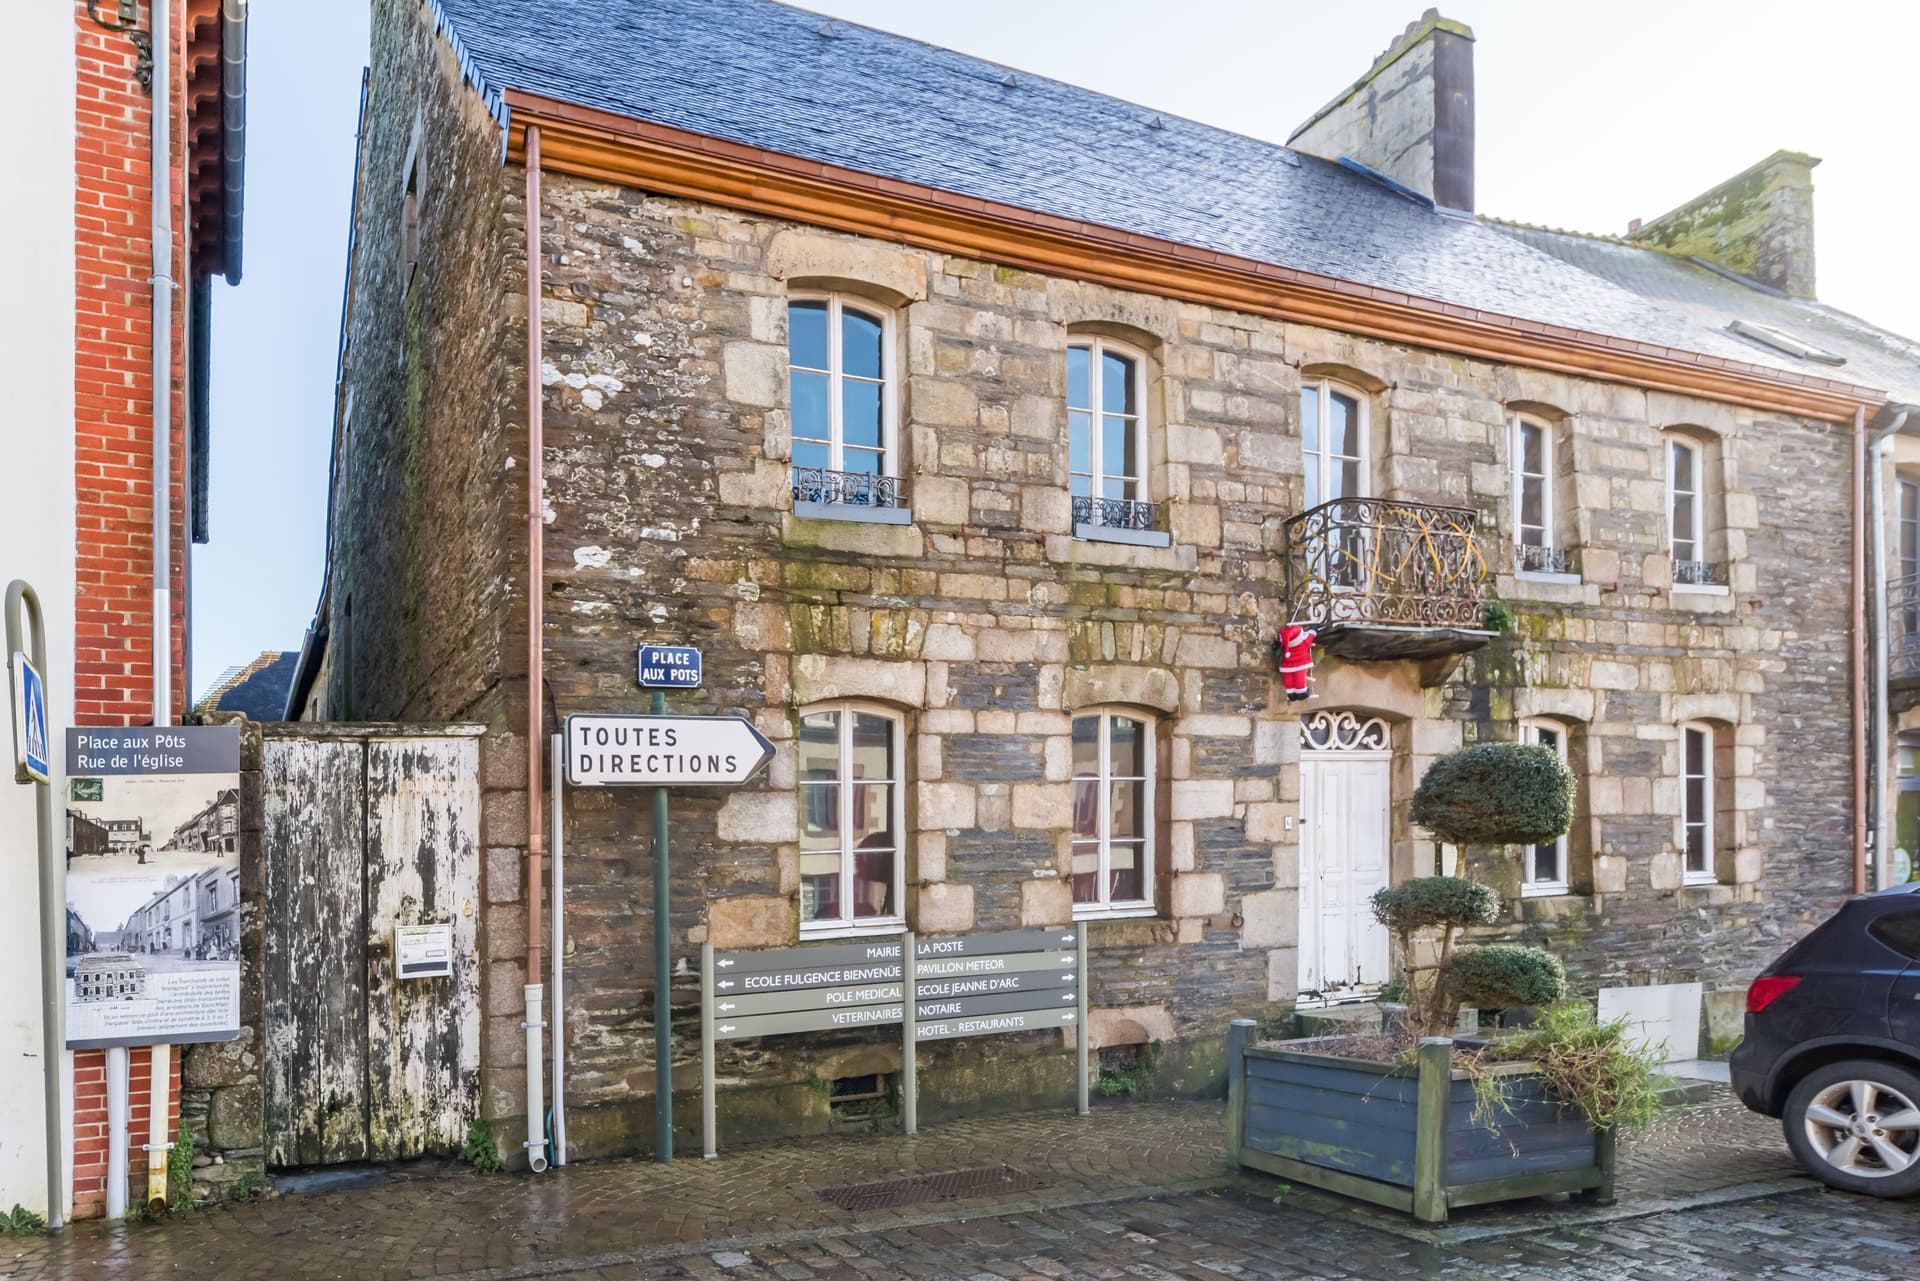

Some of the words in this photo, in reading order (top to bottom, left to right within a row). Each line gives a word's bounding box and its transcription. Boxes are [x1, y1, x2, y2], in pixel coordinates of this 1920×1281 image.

[652, 651, 690, 665] PLACE
[642, 668, 665, 681] AUX
[670, 668, 699, 682] POTS
[77, 735, 118, 749] Place
[123, 737, 149, 749] aux
[155, 734, 186, 749] Pôts
[579, 727, 677, 747] TOUTES
[77, 754, 105, 769] Rue
[111, 754, 128, 768] de
[133, 753, 184, 770] l'église
[580, 754, 737, 773] DIRECTIONS
[866, 946, 901, 959] MAIRIE
[917, 943, 931, 955] LA
[933, 941, 964, 953] POSTE
[917, 961, 964, 975] PAVILLON
[966, 959, 1005, 971] METEOR
[745, 972, 782, 989] ECOLE
[784, 969, 841, 986] FULGENCE
[917, 983, 949, 996] ECOLE
[951, 980, 988, 995] JEANNE
[989, 977, 1020, 991] D'ARC
[826, 991, 853, 1004] POLE
[855, 987, 902, 1001] MEDICAL
[831, 1007, 904, 1024] VETERINAIRES
[918, 1003, 962, 1016] NOTAIRE
[917, 1024, 950, 1037] HOTEL
[958, 1016, 1025, 1033] RESTAURANTS
